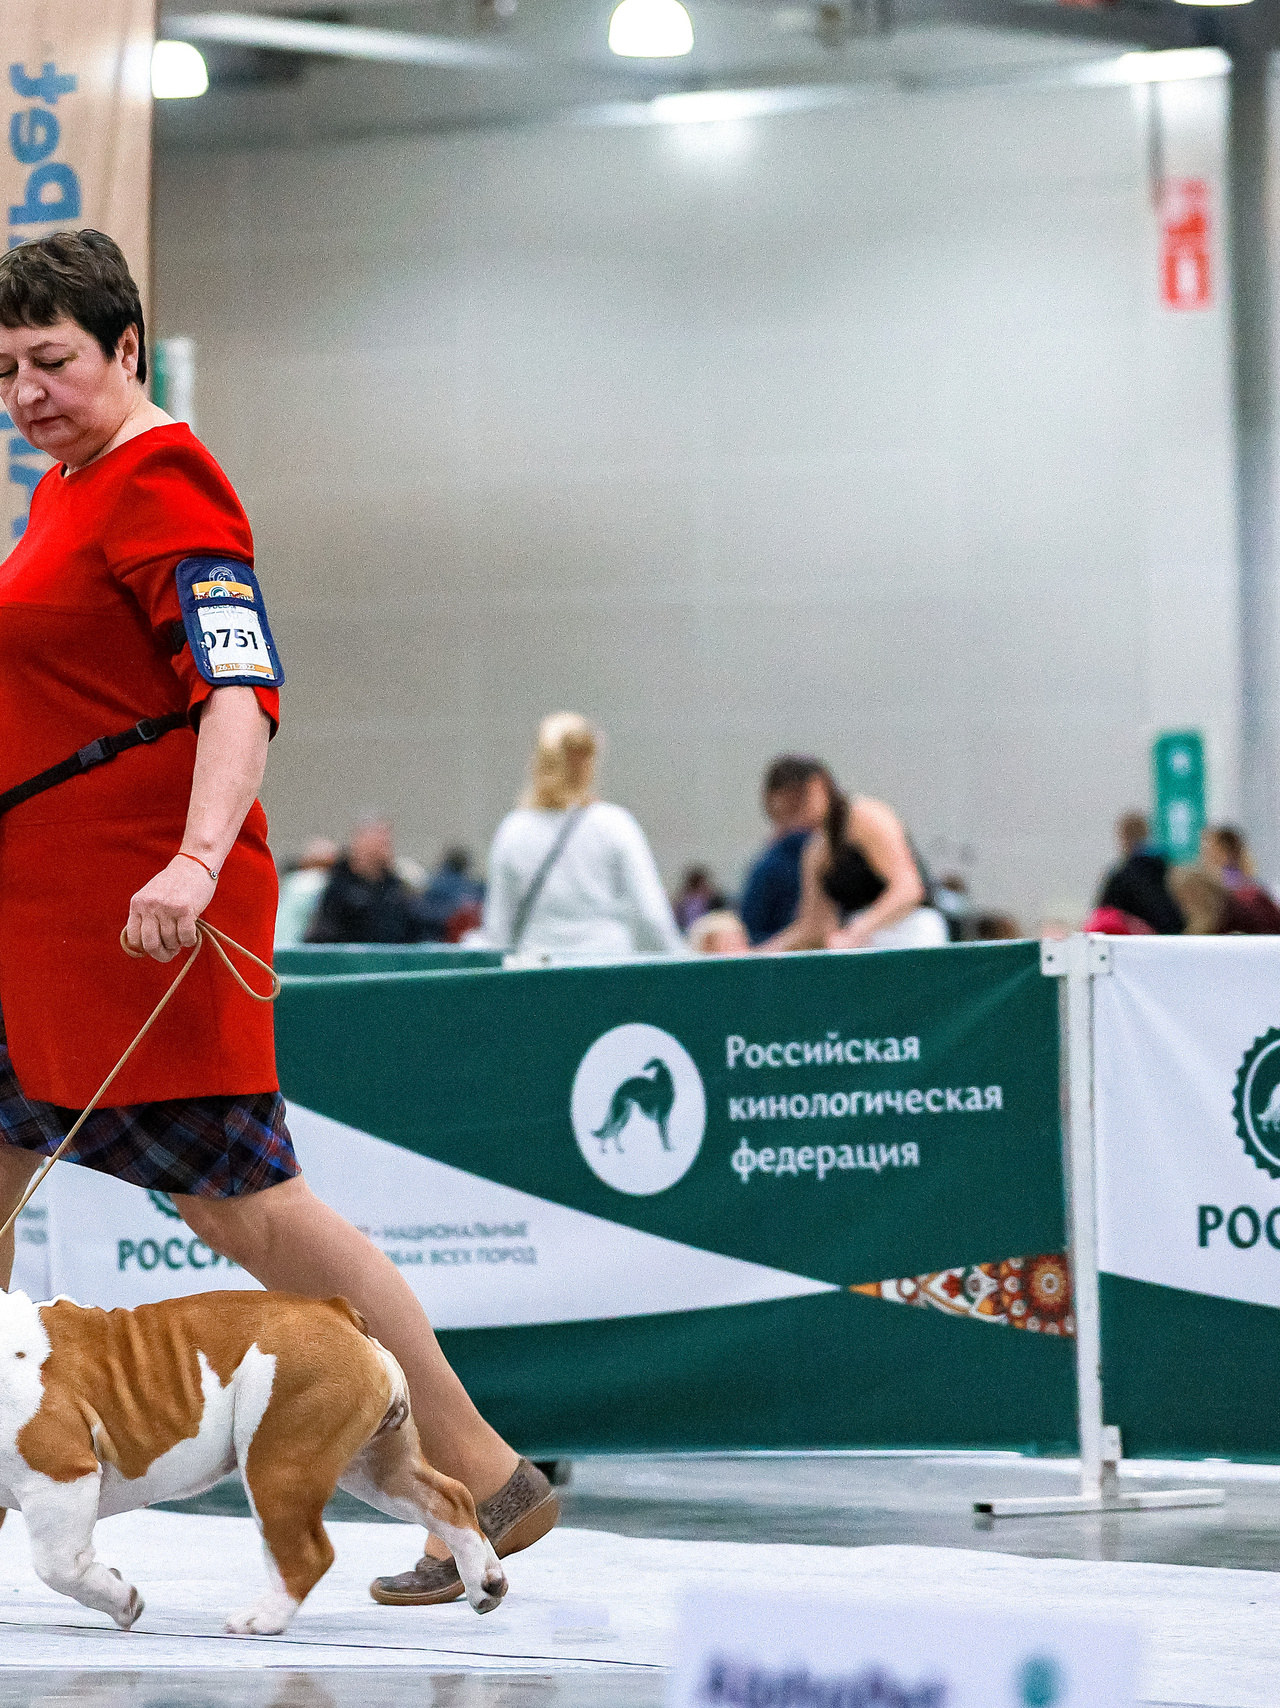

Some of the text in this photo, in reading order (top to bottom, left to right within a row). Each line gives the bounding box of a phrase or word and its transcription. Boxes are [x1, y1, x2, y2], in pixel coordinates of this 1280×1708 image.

[202, 629, 258, 650] 0751
[726, 1032, 920, 1069] Российская
[729, 1085, 1003, 1121] кинологическая
[731, 1137, 920, 1183] федерация
[118, 1237, 242, 1271] РОСС
